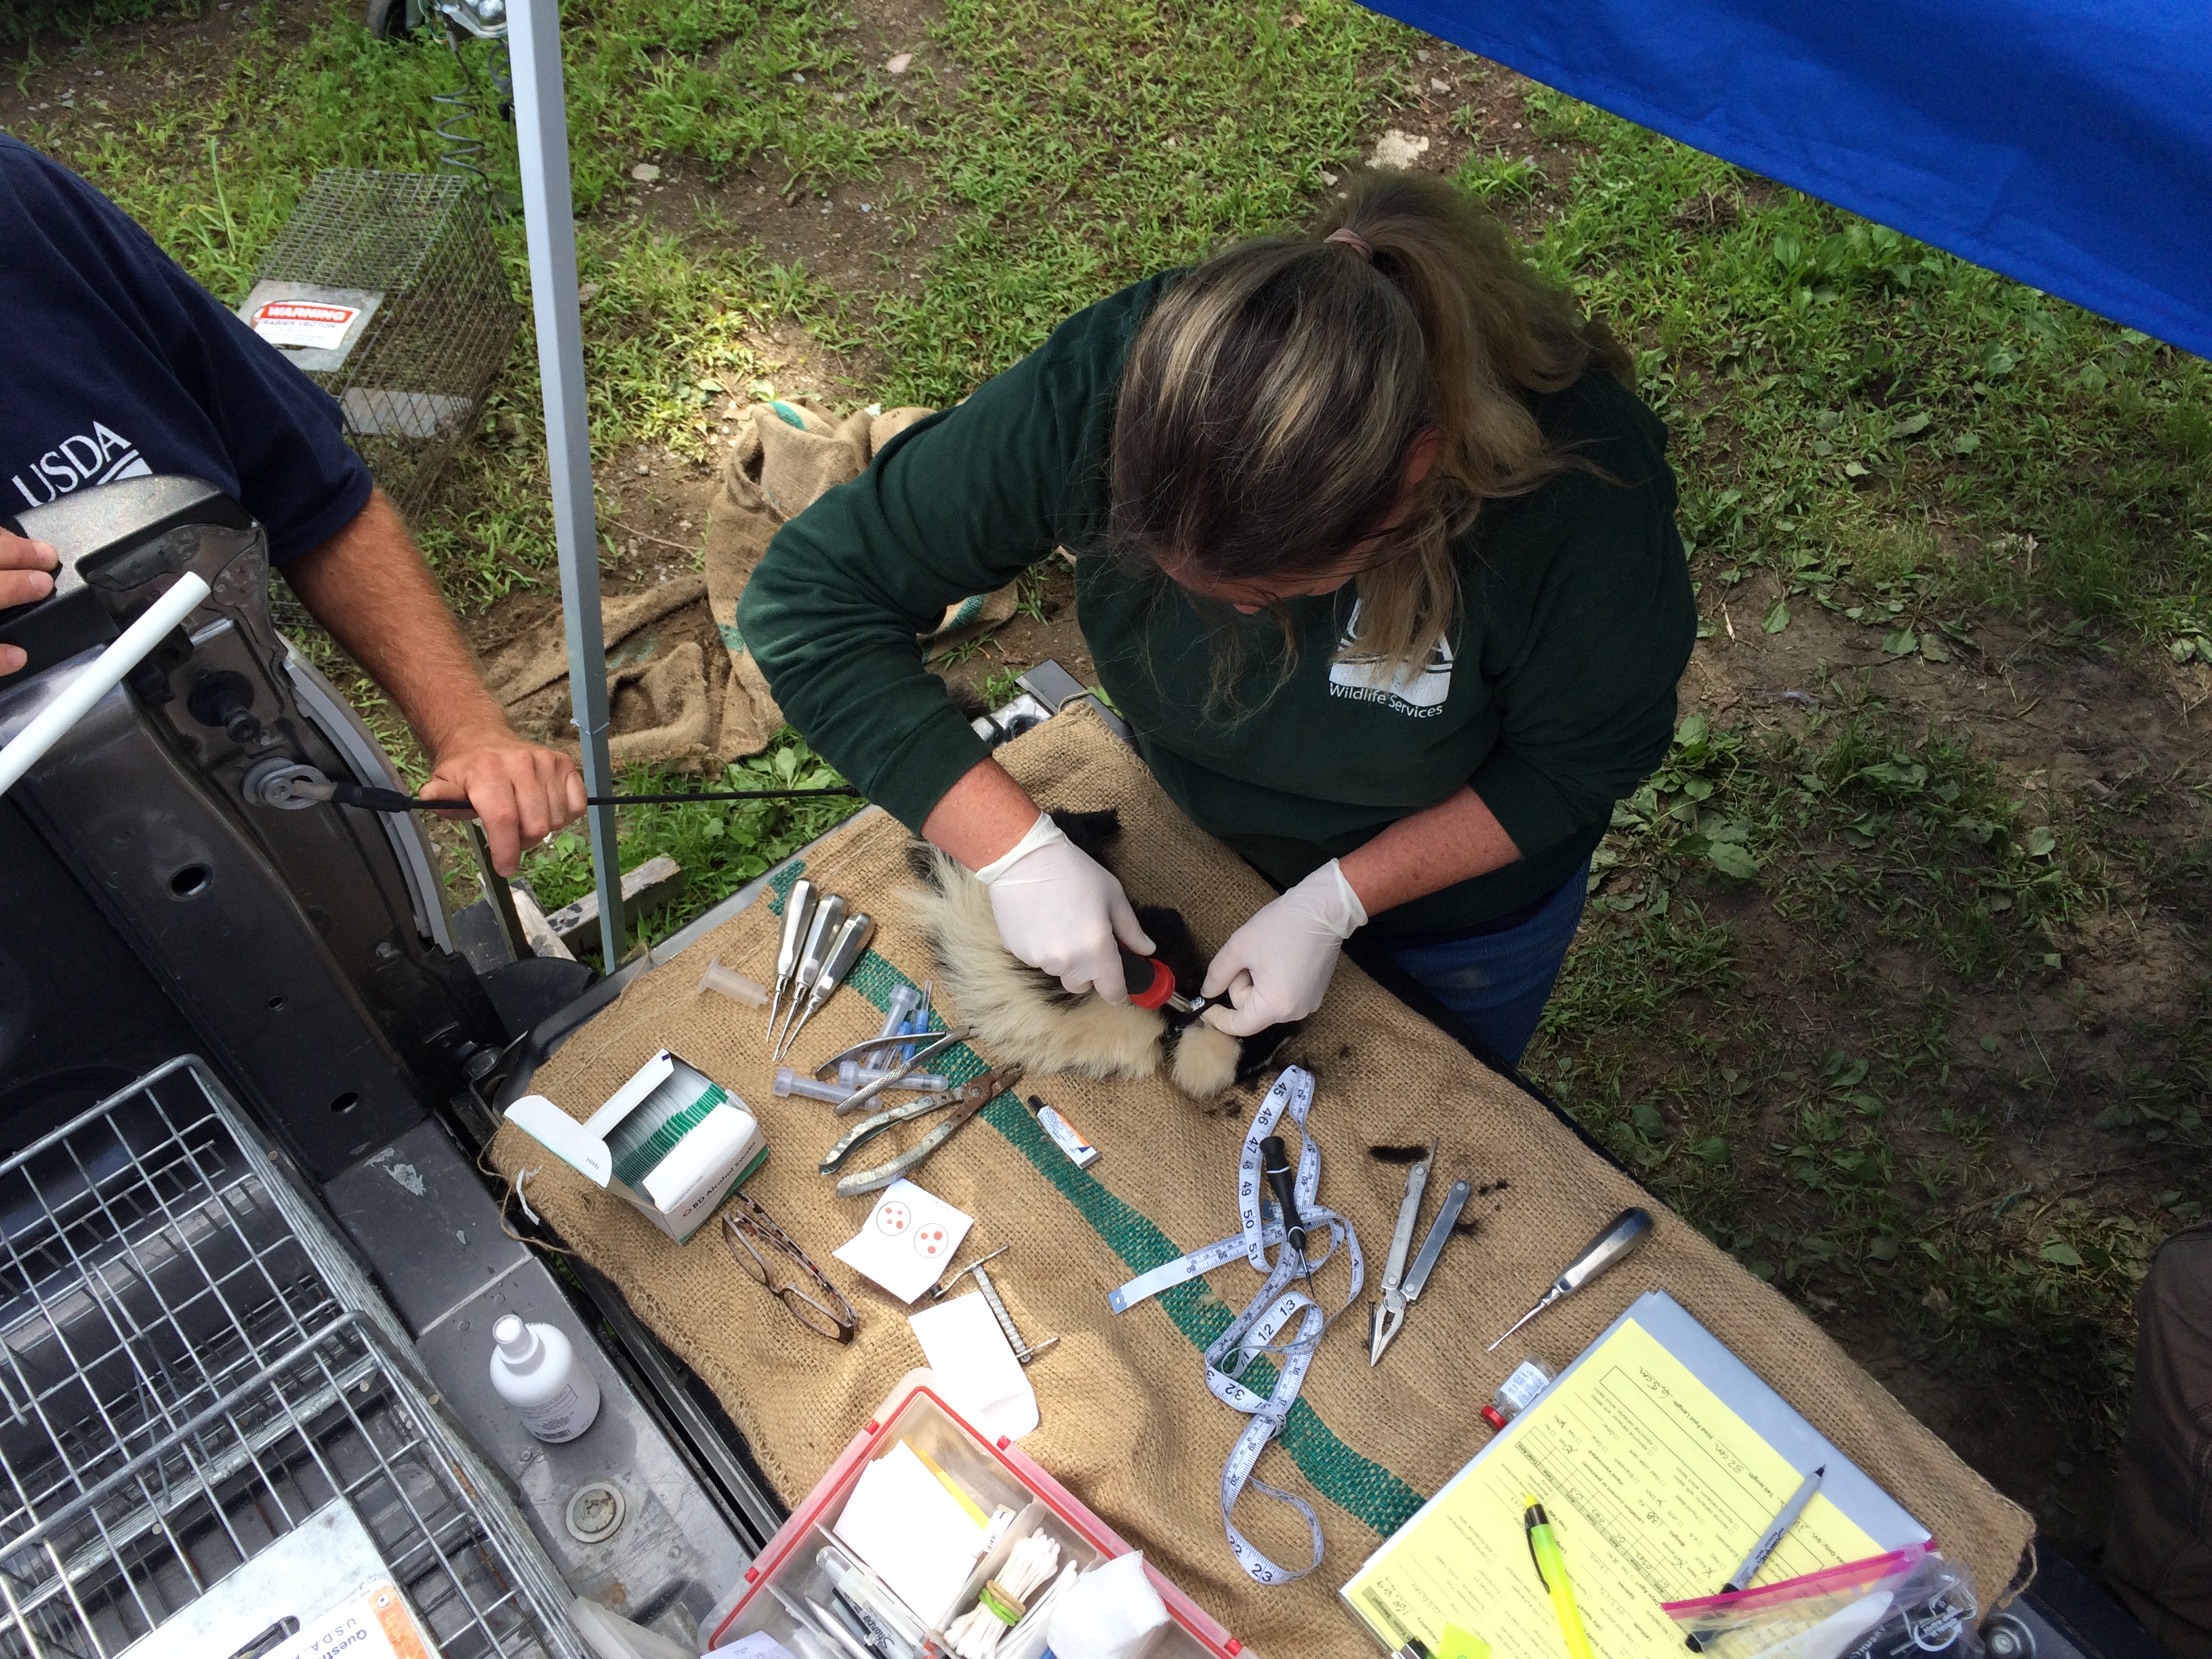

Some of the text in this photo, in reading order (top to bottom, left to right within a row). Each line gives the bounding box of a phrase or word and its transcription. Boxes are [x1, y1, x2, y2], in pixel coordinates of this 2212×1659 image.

[266, 306, 346, 321] WARNING
[11, 420, 132, 508] USDA
[1329, 682, 1443, 719] Wildlife Services
[1273, 1082, 1287, 1097] 45
[1258, 1107, 1272, 1126] 46
[1247, 1136, 1258, 1154] 47
[1242, 1160, 1254, 1170] 48
[692, 1141, 756, 1209] BD Alcohol Swabs
[1242, 1181, 1252, 1196] 49
[1243, 1209, 1254, 1229] 50
[1248, 1242, 1258, 1261] 51
[1186, 1265, 1196, 1274] 60
[1279, 1298, 1296, 1317] 13
[1257, 1323, 1275, 1342] 12
[1292, 1366, 1301, 1376] 16
[1635, 1366, 1653, 1383] cm
[1225, 1382, 1245, 1401] 32
[1589, 1393, 1603, 1407] lesion
[1592, 1386, 1606, 1400] lesion
[1603, 1397, 1616, 1410] w/out
[1601, 1422, 1615, 1436] Other
[1688, 1415, 1702, 1429] Foot
[1567, 1428, 1576, 1438] Yes
[1589, 1433, 1603, 1448] Other
[1627, 1430, 1649, 1452] Abnormal
[1632, 1425, 1654, 1446] Abnormal
[1700, 1426, 1713, 1440] Hind
[1248, 1441, 1258, 1452] 19
[1515, 1441, 1528, 1454] Amt.
[1711, 1441, 1729, 1460] cm
[1525, 1452, 1538, 1465] Total
[1628, 1448, 1660, 1481] Died under care
[1542, 1469, 1555, 1481] Time
[1612, 1456, 1635, 1479] Brainstem
[1674, 1465, 1689, 1479] lesion
[1230, 1473, 1241, 1487] 20
[1525, 1472, 1550, 1496] Missing/stolen
[1540, 1478, 1554, 1493] Sprung
[1610, 1472, 1624, 1486] Hand
[1671, 1473, 1686, 1488] lesion
[1686, 1477, 1700, 1491] w/out
[1746, 1470, 1774, 1498] Tail length
[1525, 1480, 1545, 1501] Malfunction
[1563, 1491, 1576, 1503] Amt.
[1605, 1485, 1625, 1504] (current
[1643, 1488, 1656, 1500] DNA
[1622, 1502, 1645, 1525] Lactation
[1666, 1509, 1679, 1521] JAW
[1674, 1494, 1700, 1519] Found dead
[1510, 1514, 1525, 1529] Other
[1556, 1517, 1570, 1531] Trap
[1584, 1513, 1598, 1525] Time
[1711, 1512, 1729, 1530] Normal
[1717, 1507, 1734, 1524] Normal
[1443, 1513, 1490, 1559] Handcaught/Gathered
[1465, 1524, 1487, 1545] incidental
[1607, 1535, 1620, 1548] Amt.
[1666, 1528, 1686, 1547] Weight:
[1809, 1530, 1822, 1544] SVL
[1229, 1535, 1243, 1559] 22
[1660, 1540, 1678, 1558] Female
[1714, 1533, 1739, 1558] Euthanized
[1433, 1553, 1448, 1568] health
[1629, 1557, 1642, 1571] Time
[1694, 1555, 1707, 1569] Adult
[1708, 1551, 1721, 1564] PM2
[1251, 1562, 1273, 1582] 23
[1503, 1564, 1525, 1586] collection
[1620, 1564, 1631, 1576] Yes
[1685, 1565, 1698, 1578] Male
[1772, 1561, 1790, 1578] Animal
[1459, 1583, 1487, 1610] Surveillance
[1574, 1581, 1588, 1595] None
[1634, 1579, 1661, 1606] Days Ago?
[1445, 1579, 1481, 1616] Coordinated TVR
[1509, 1583, 1551, 1627] Non-WS euthanized
[1448, 1601, 1461, 1615] Other
[1536, 1600, 1557, 1621] Non-WS
[1576, 1603, 1604, 1631] ORV Naive?
[1597, 1605, 1636, 1644] Dog food polymer
[1644, 1609, 1663, 1628] capture
[861, 1612, 896, 1648] Sharpie
[1413, 1615, 1443, 1645] Frequency
[1498, 1625, 1521, 1647] enhanced
[1528, 1635, 1541, 1648] dead
[1584, 1631, 1601, 1647] Study
